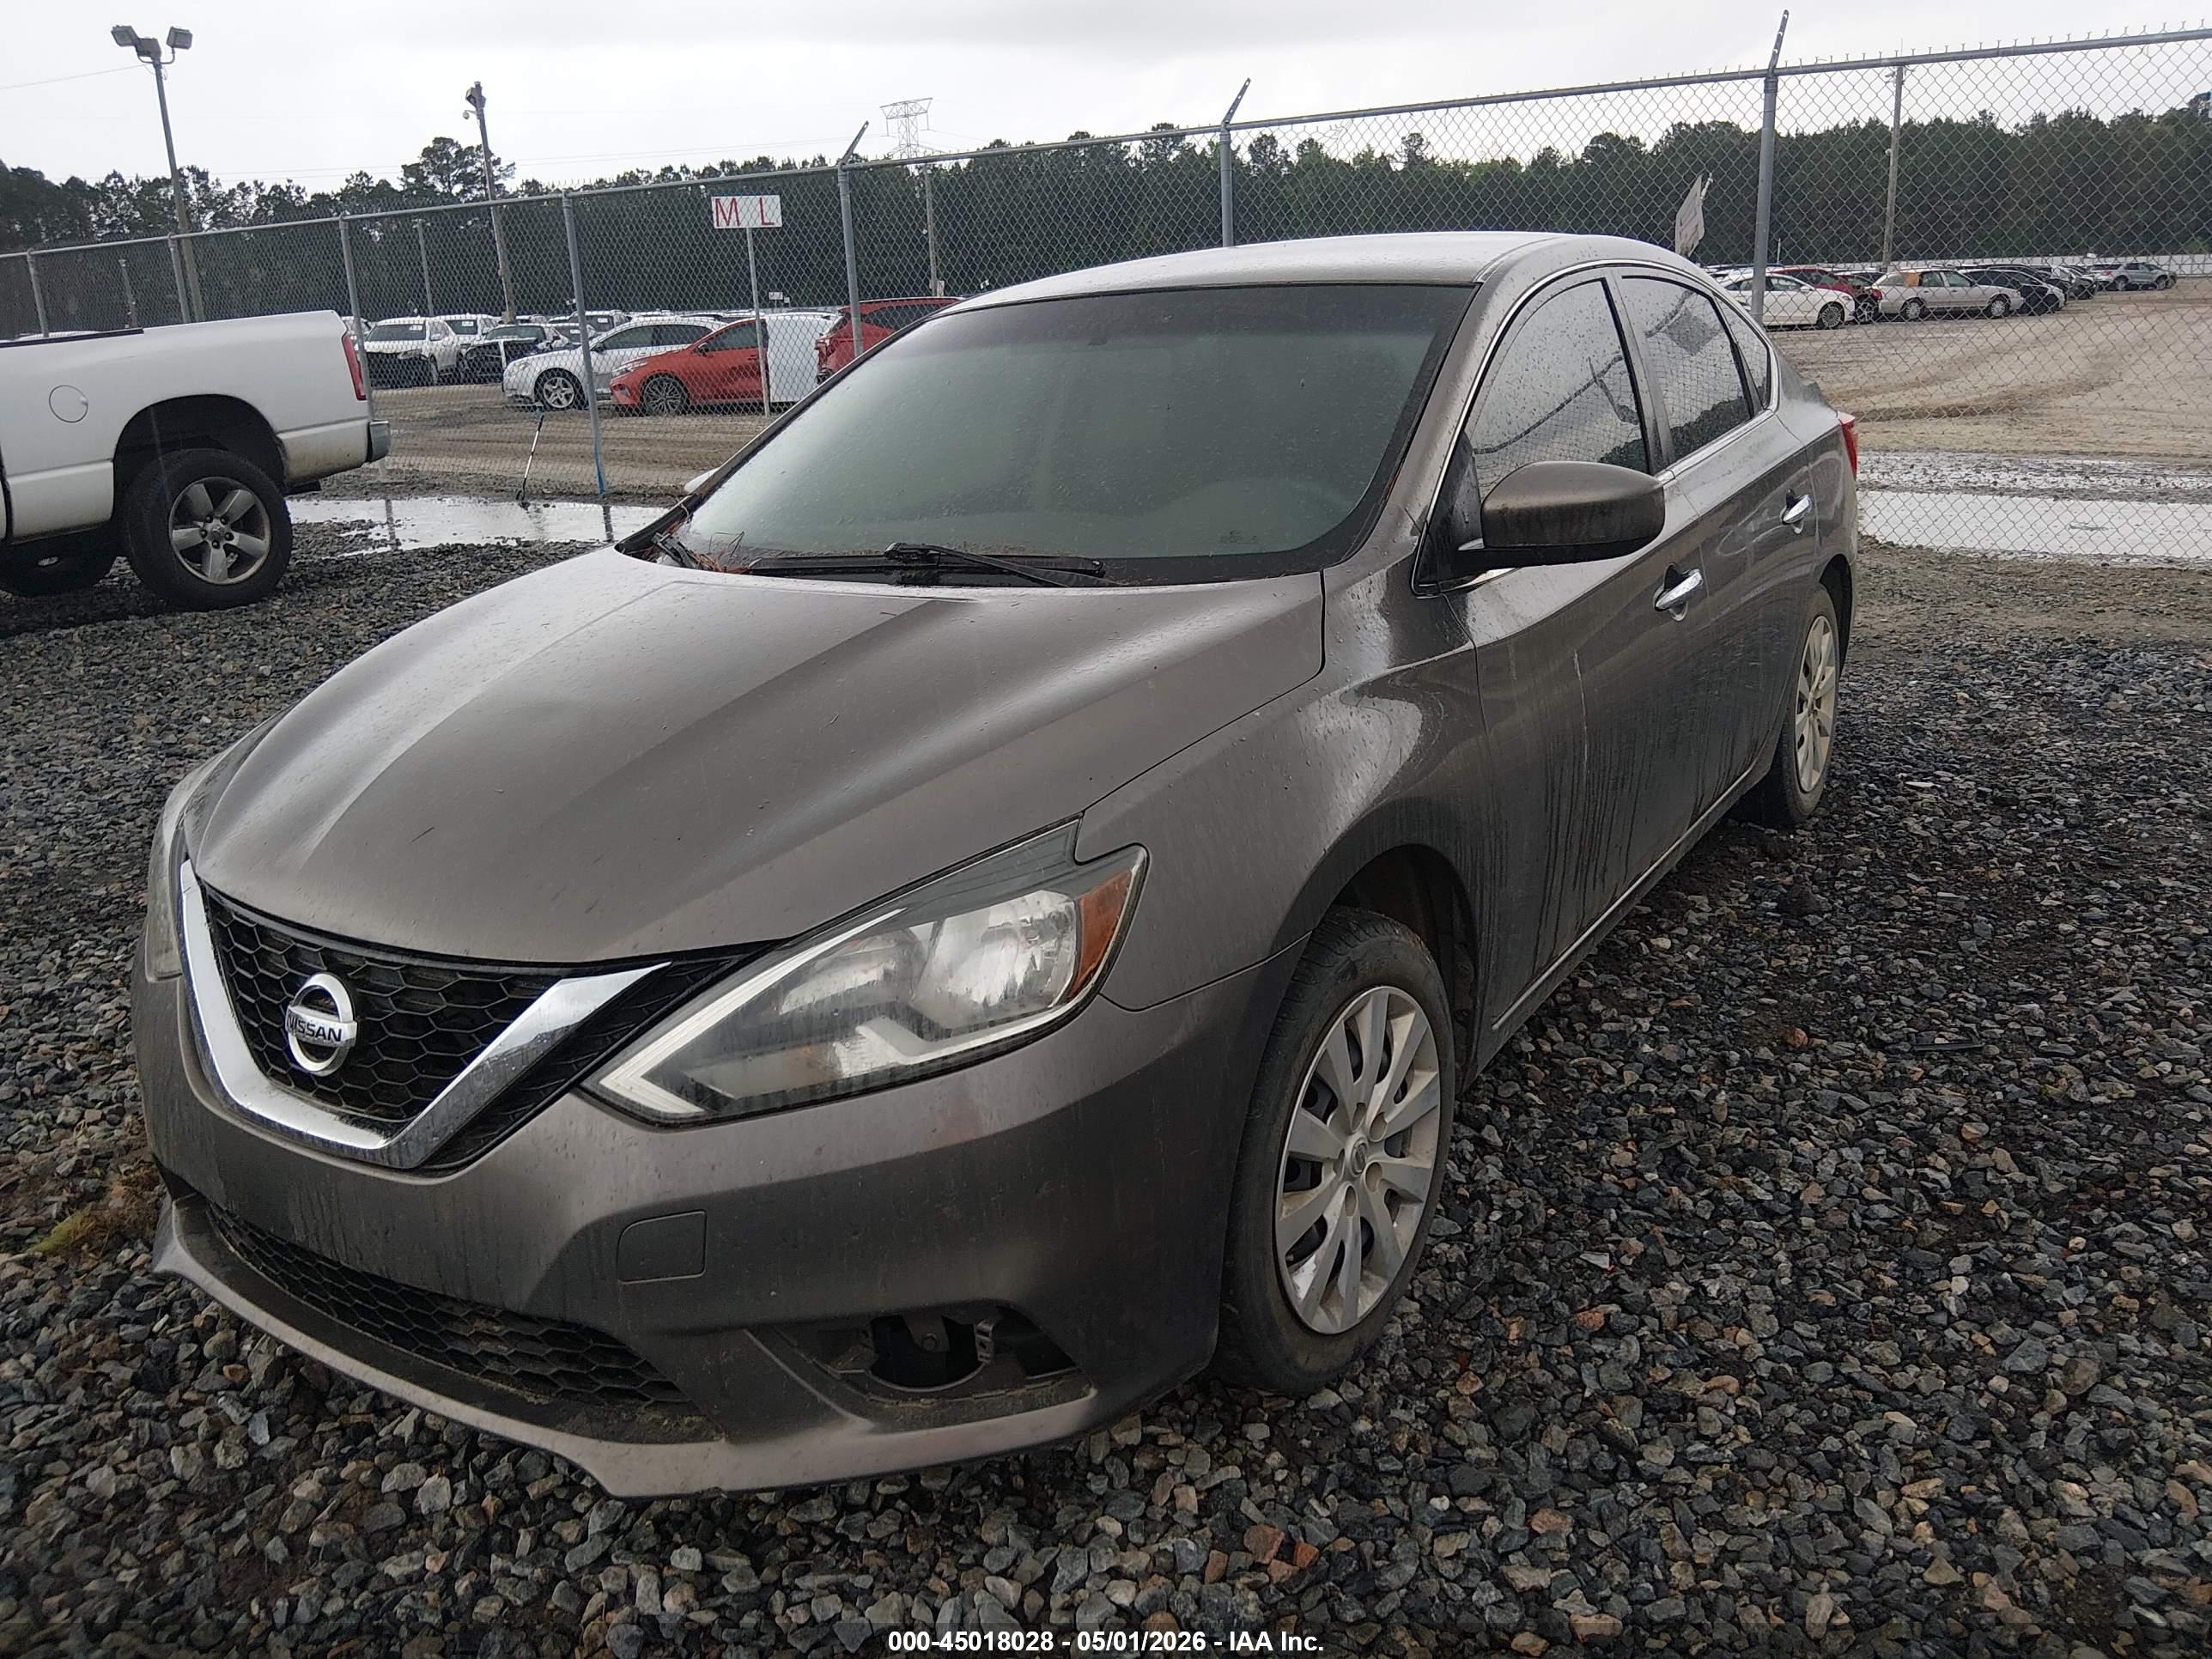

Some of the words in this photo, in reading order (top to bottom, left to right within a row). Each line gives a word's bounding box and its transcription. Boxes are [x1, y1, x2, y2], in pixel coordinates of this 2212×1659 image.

[714, 197, 741, 227] M
[758, 196, 775, 226] L
[287, 1014, 343, 1042] NISSAN
